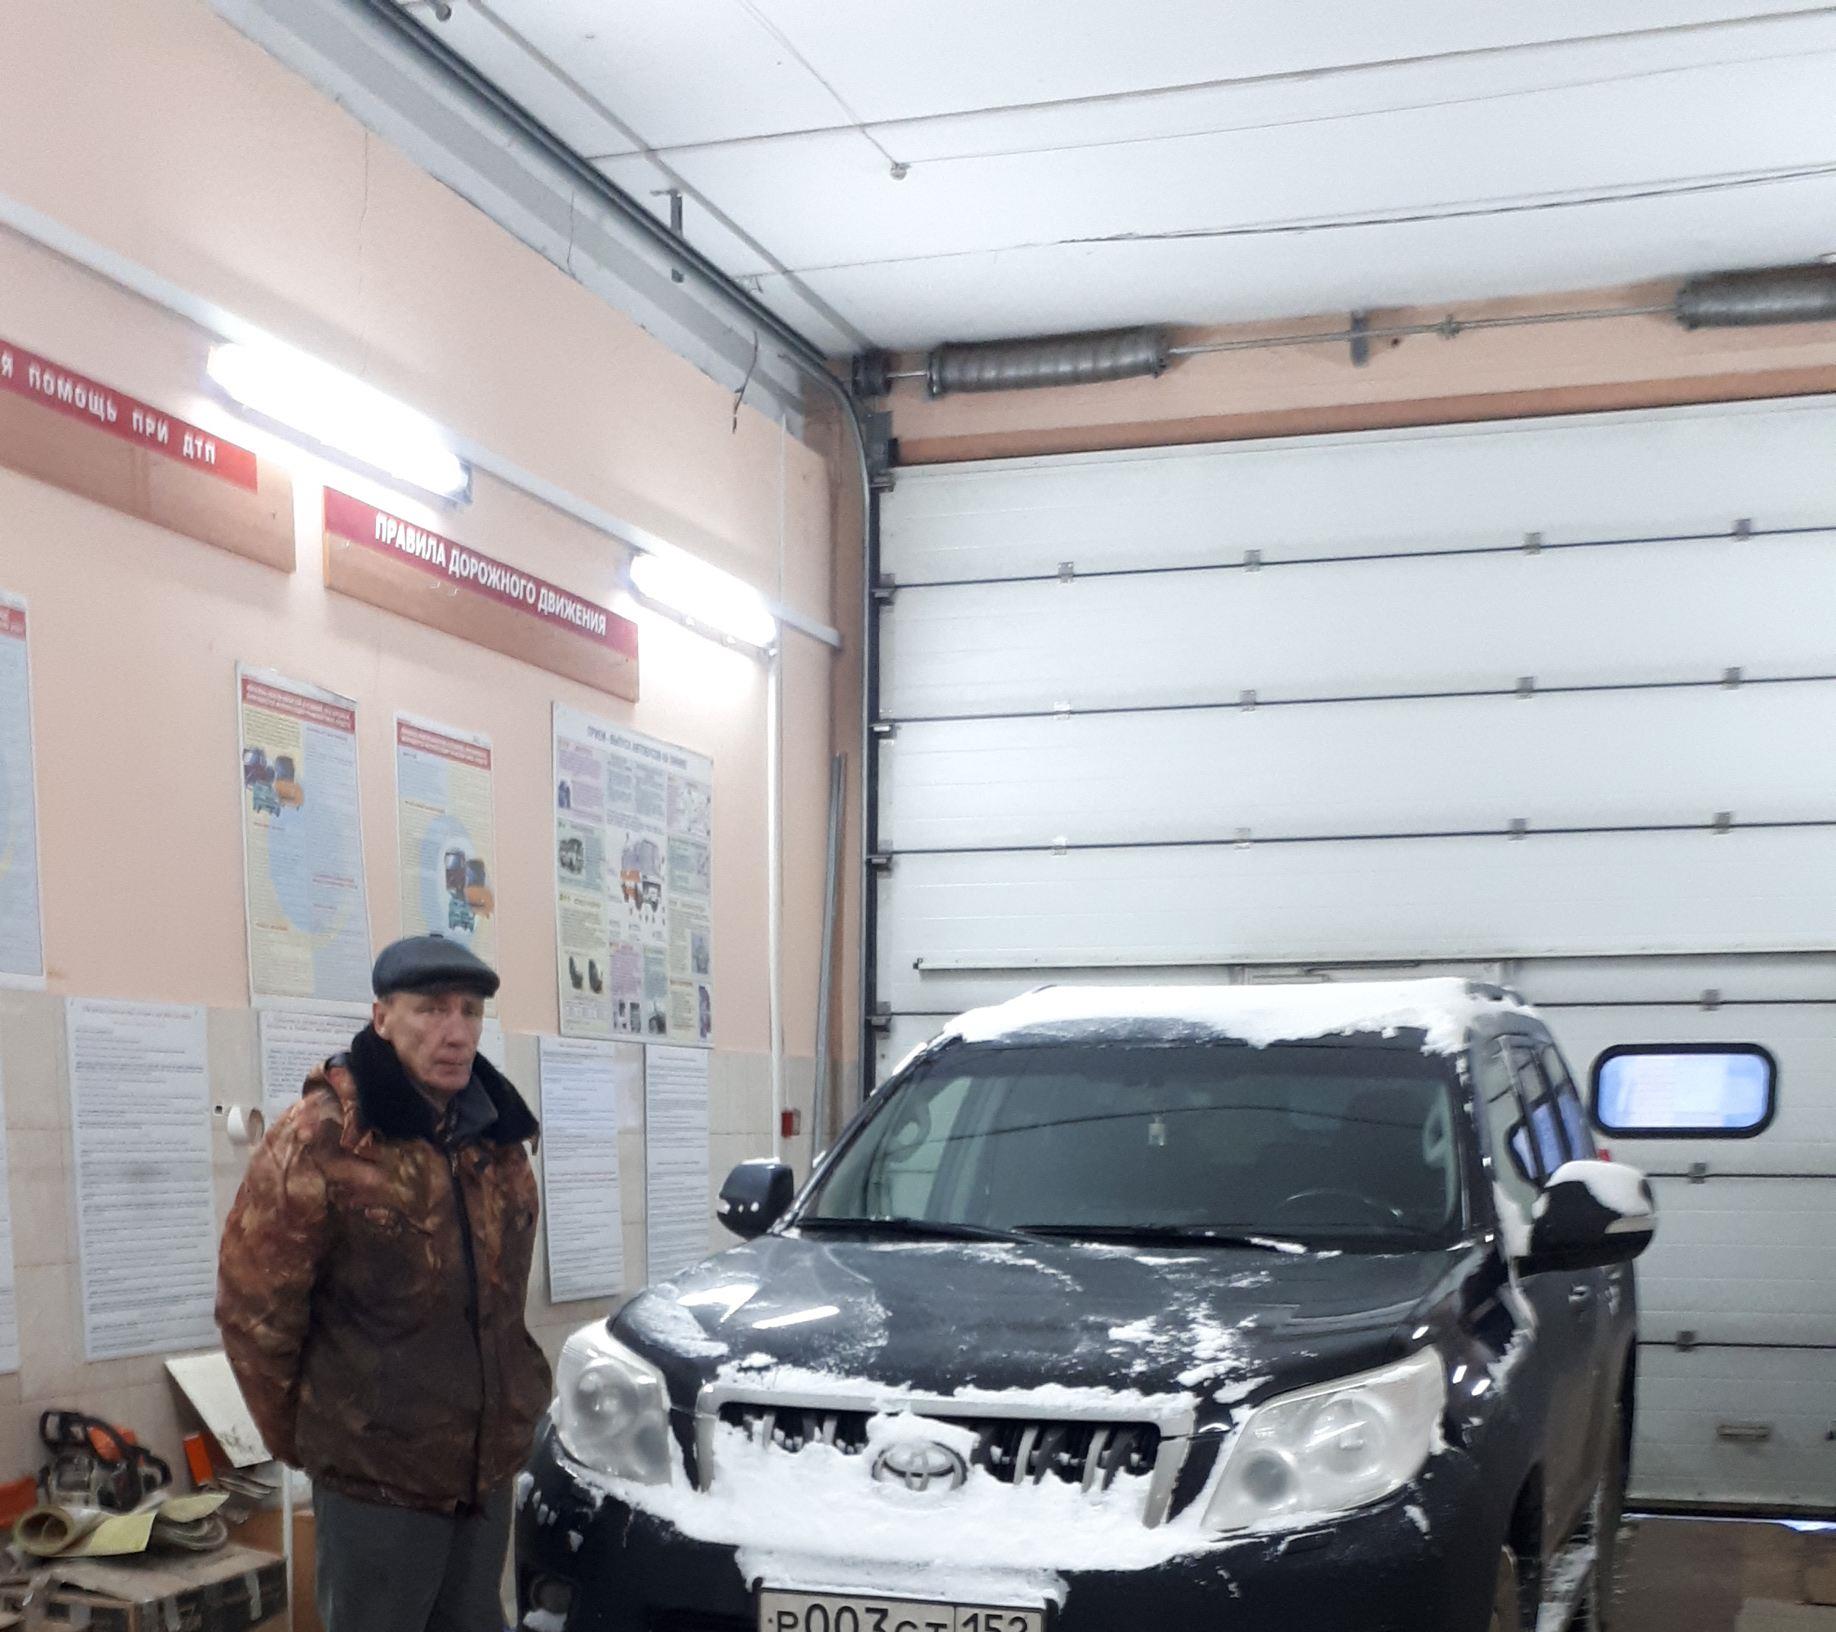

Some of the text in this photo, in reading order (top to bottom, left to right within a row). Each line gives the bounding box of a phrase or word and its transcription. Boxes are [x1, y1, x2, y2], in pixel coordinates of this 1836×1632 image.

[29, 363, 117, 422] ПОМОЩЬ
[132, 410, 169, 444] ПРИ
[183, 432, 217, 464] ДТП
[375, 511, 607, 635] ПРАВИЛА ДОРОЖНОГО ДВИЖЕНИЯ
